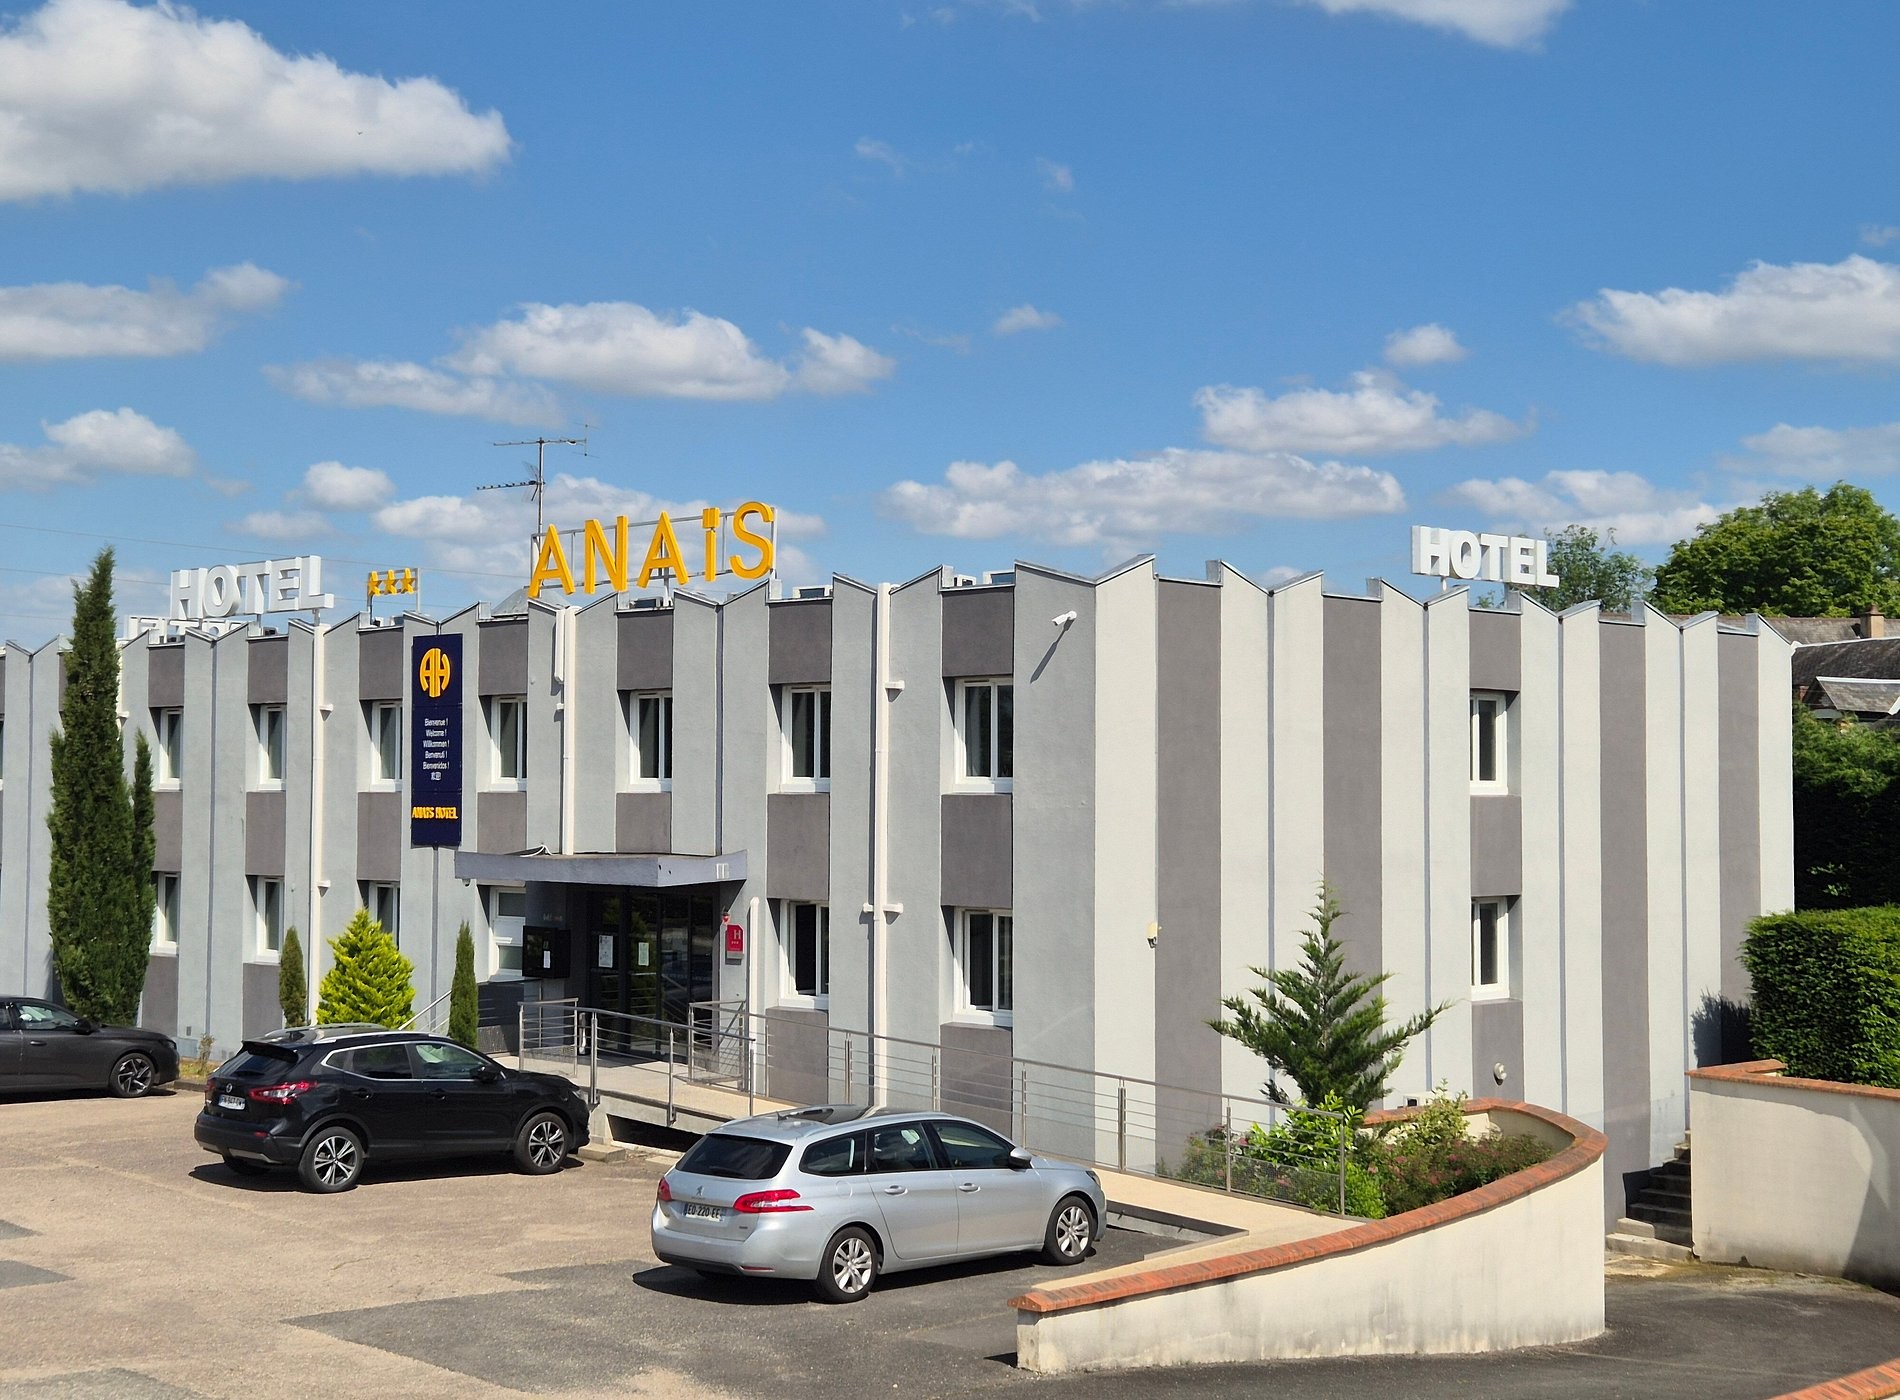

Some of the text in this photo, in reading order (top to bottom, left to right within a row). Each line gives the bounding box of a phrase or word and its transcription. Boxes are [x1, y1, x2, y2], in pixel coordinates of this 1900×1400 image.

[1412, 525, 1560, 588] HOTEL
[170, 555, 334, 619] HOTEL
[425, 728, 445, 737] Welcome
[422, 739, 446, 748] Willkommen
[733, 929, 742, 940] H
